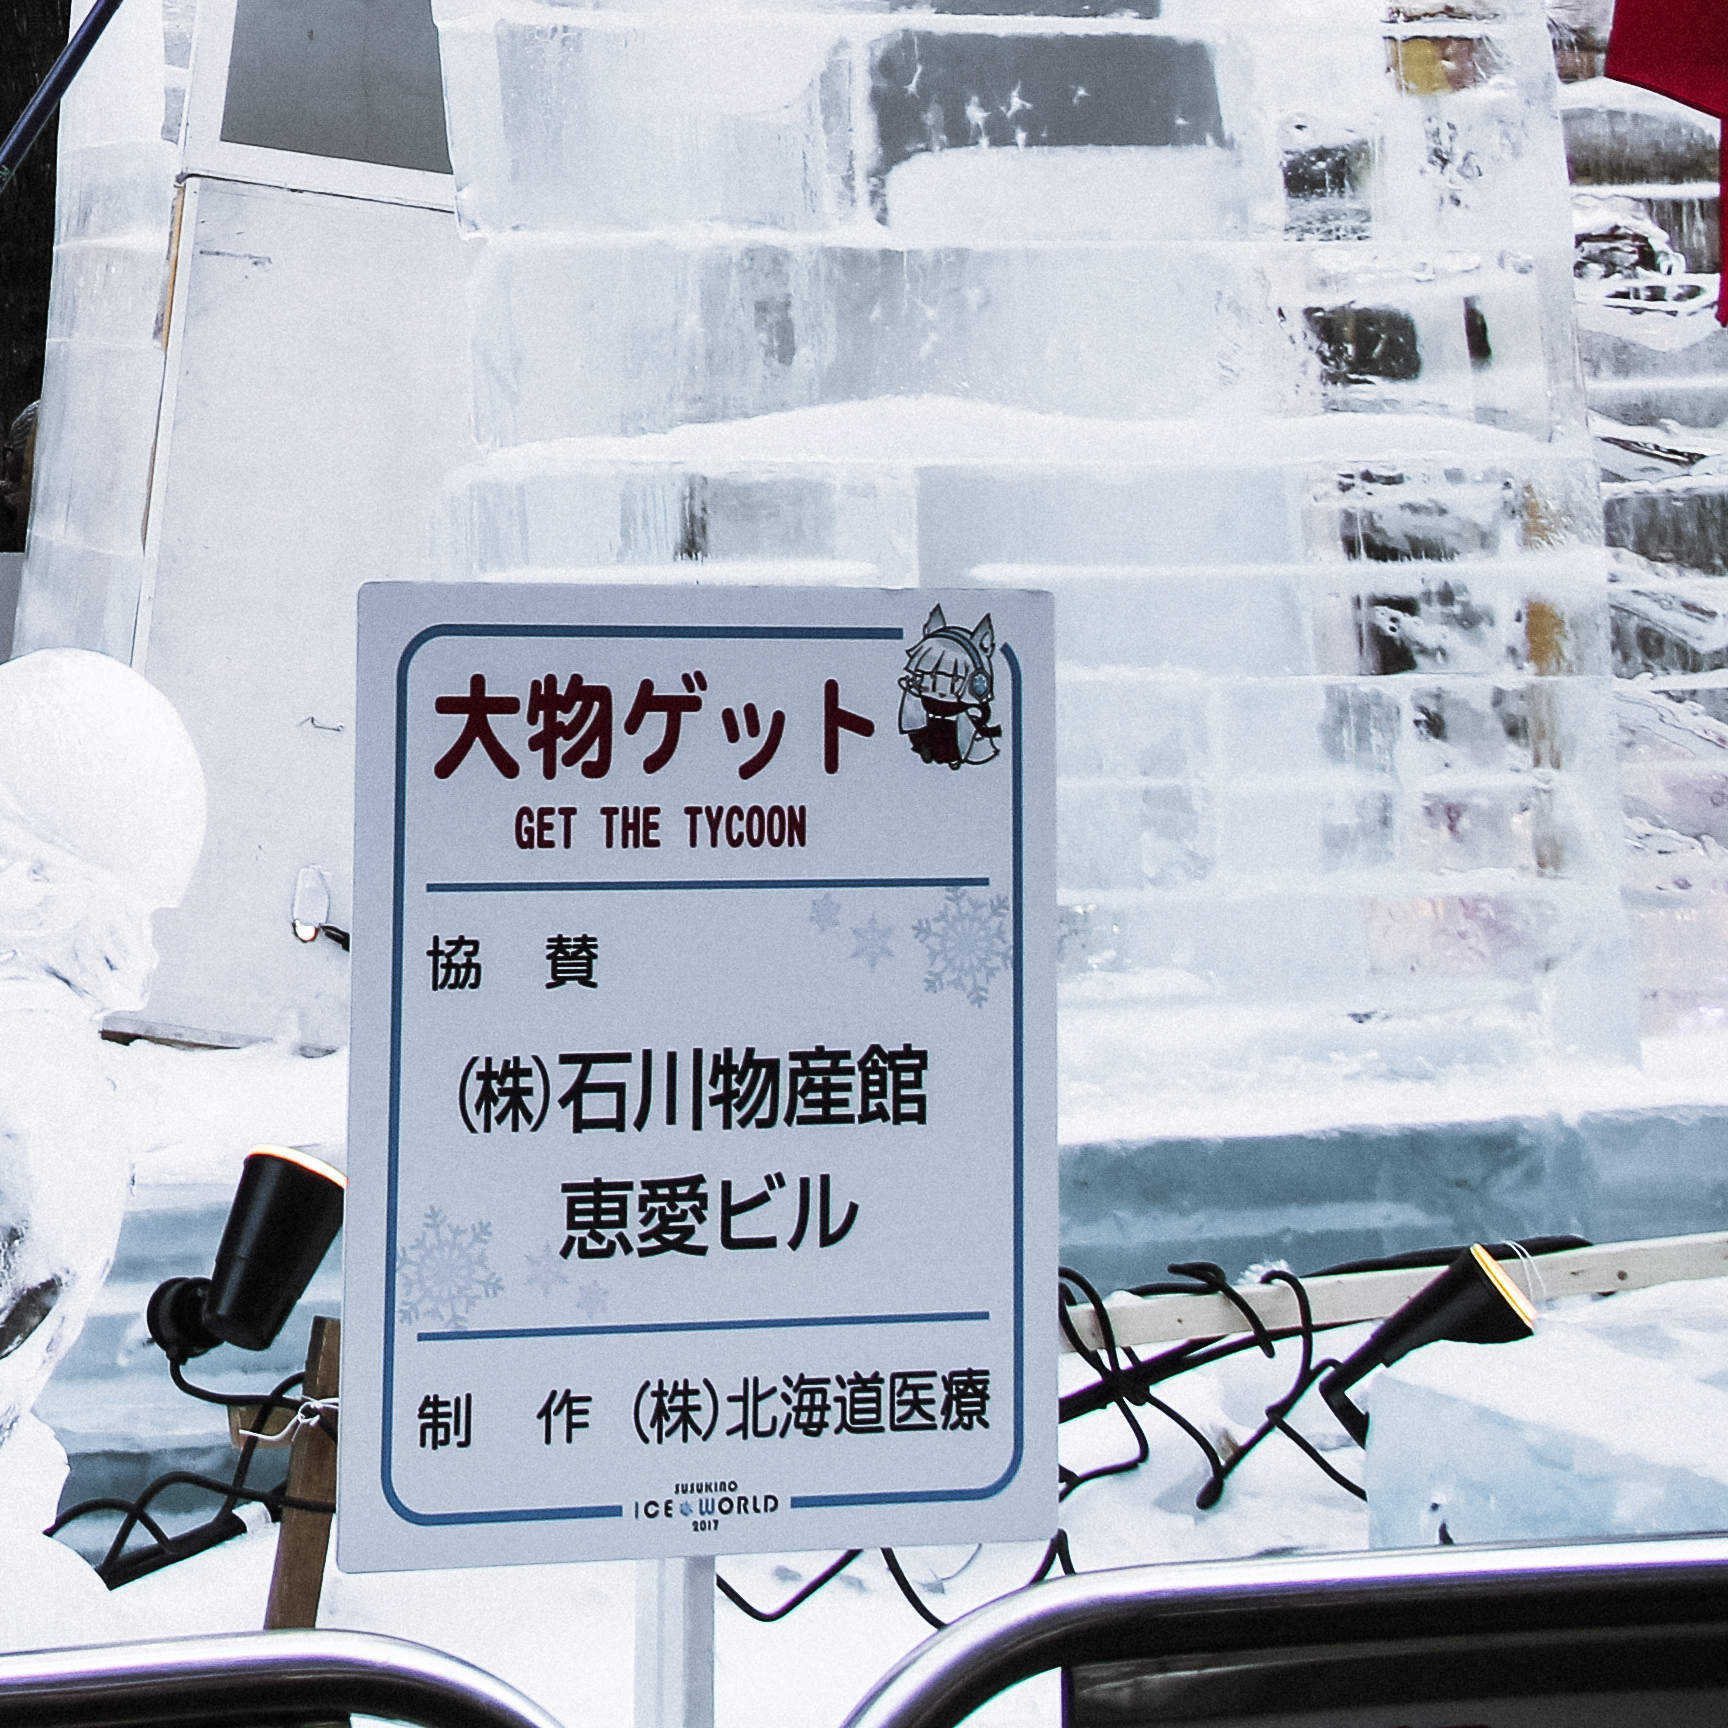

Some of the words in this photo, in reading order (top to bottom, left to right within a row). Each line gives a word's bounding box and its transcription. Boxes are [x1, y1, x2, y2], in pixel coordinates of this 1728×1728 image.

[434, 670, 875, 780] 大物ゲット
[514, 805, 578, 850] GET
[600, 805, 662, 849] THE
[683, 804, 808, 849] TYCOON
[458, 1043, 930, 1134] (株)石川物産館
[559, 1172, 860, 1261] 恵愛ビル
[633, 1367, 992, 1446] (株)北海道医療
[634, 1499, 673, 1520] ICE
[698, 1484, 780, 1516] WORLD
[674, 1480, 739, 1495] SUSUKINO
[692, 1519, 720, 1532] 2017
